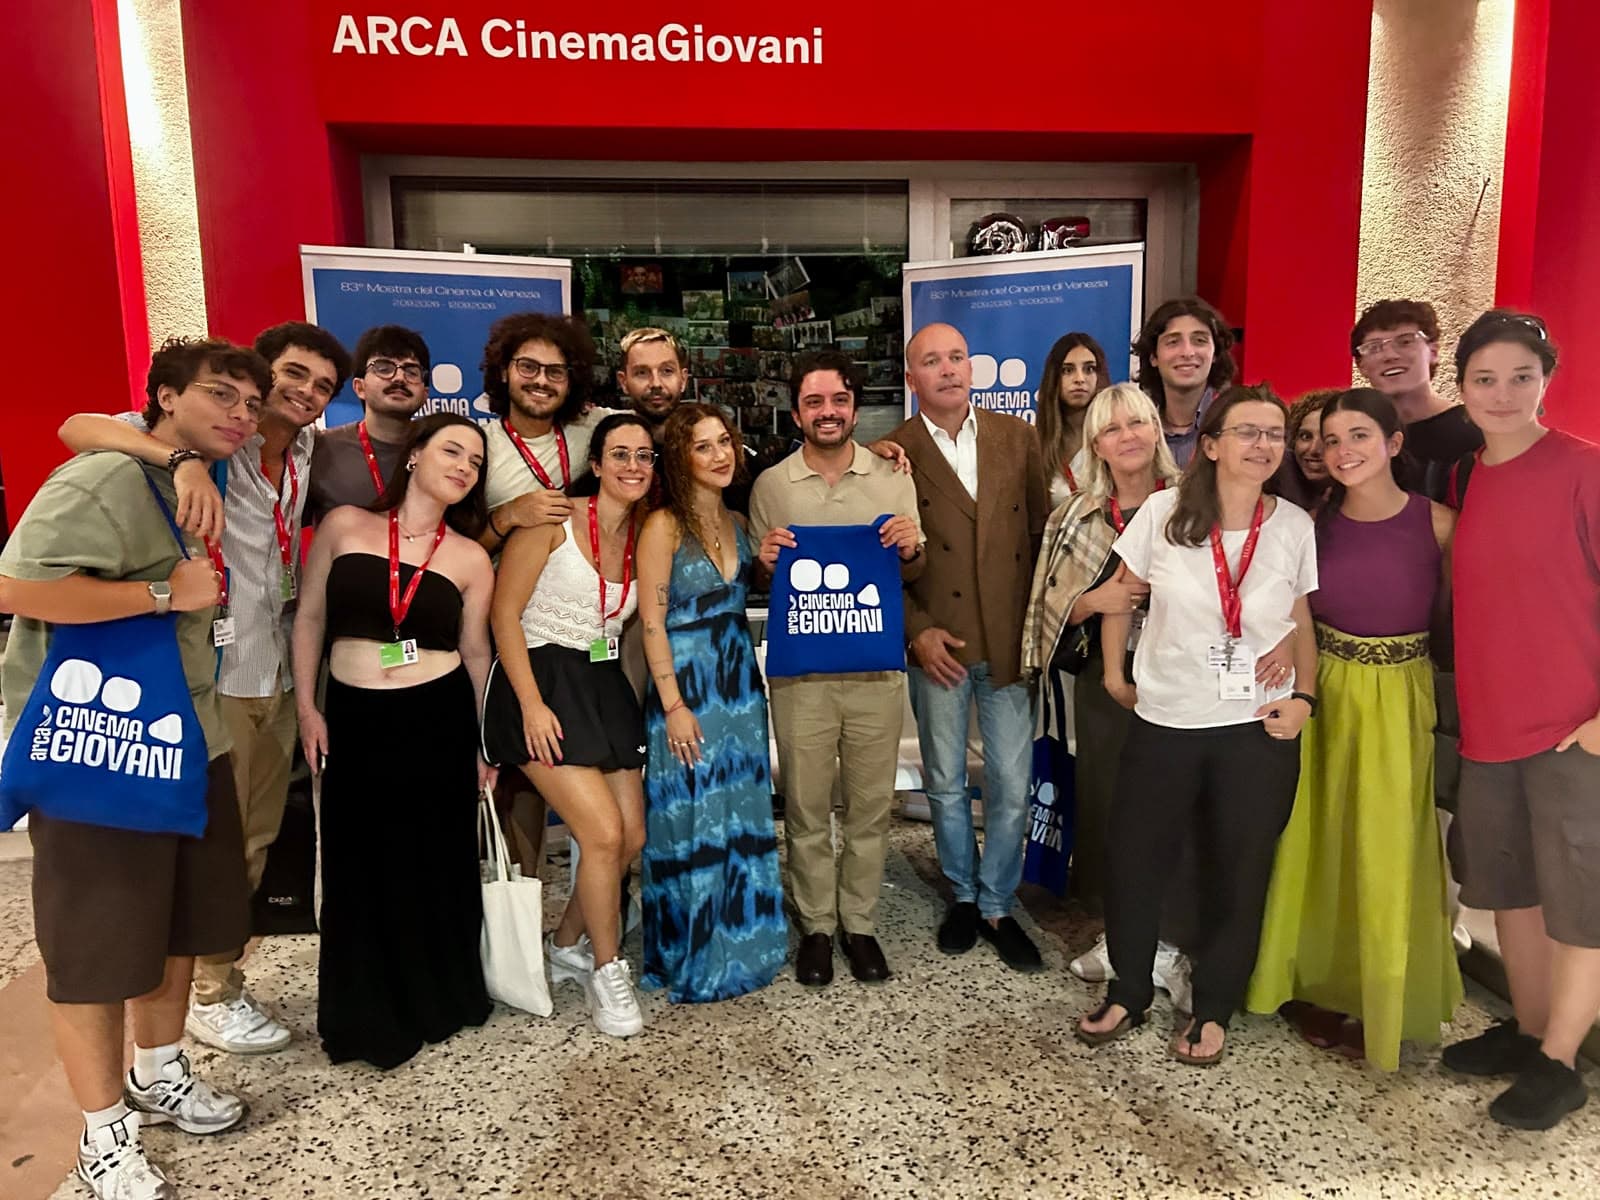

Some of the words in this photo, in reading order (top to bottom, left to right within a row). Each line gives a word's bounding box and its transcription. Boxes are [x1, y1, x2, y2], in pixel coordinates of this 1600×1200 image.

[331, 15, 469, 57] ARCA
[480, 18, 824, 64] CinemaGiovani
[367, 283, 412, 294] Mostra
[414, 285, 433, 295] del
[434, 286, 481, 297] Cinema
[483, 287, 494, 297] di
[495, 288, 541, 299] Venezia
[951, 288, 989, 299] Mostra
[990, 286, 1008, 295] del
[1008, 284, 1051, 294] Cinema
[1052, 282, 1063, 291] di
[1064, 280, 1109, 289] Venezia
[971, 391, 1031, 410] CINEMA
[798, 593, 855, 610] CINEMA
[787, 610, 799, 635] arca
[799, 608, 883, 634] GIOVANI
[55, 705, 144, 742] CINEMA
[30, 727, 52, 761] arca
[49, 729, 184, 780] GIOVANI
